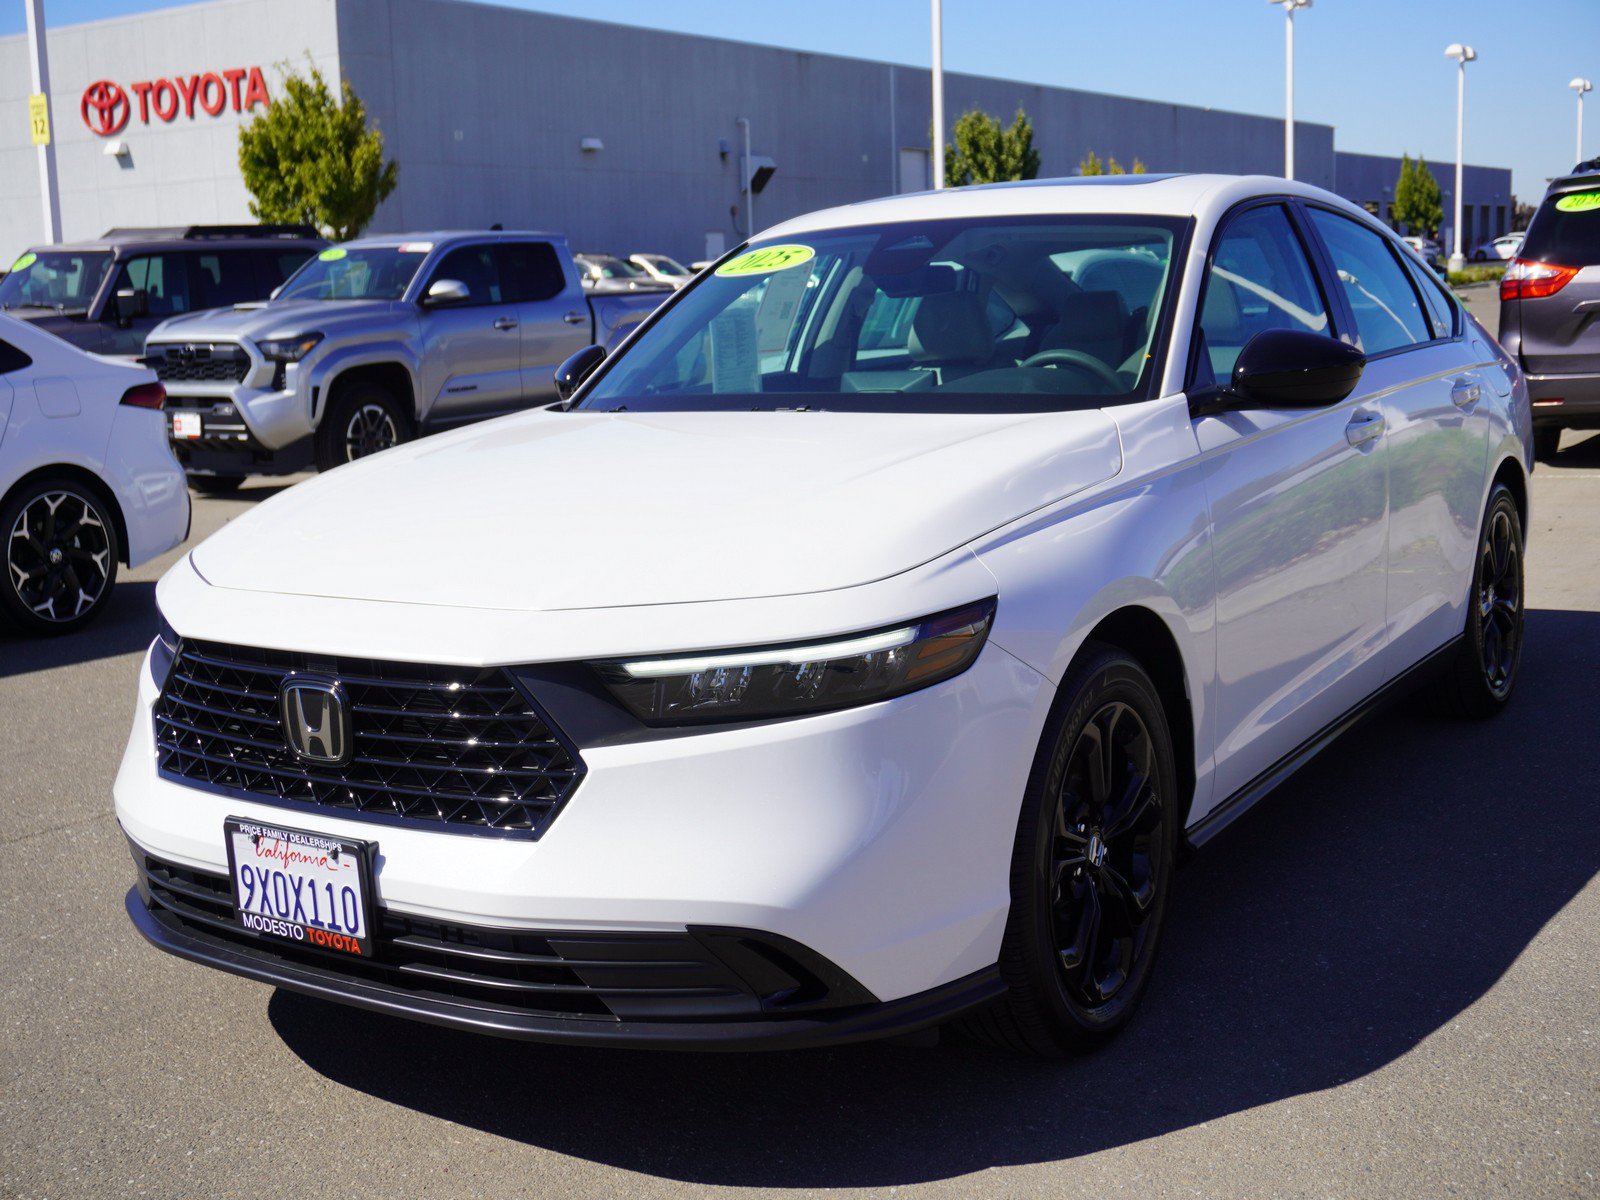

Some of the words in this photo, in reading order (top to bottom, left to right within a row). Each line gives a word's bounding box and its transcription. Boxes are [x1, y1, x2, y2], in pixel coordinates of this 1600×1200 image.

[131, 66, 270, 125] TOYOTA
[34, 118, 46, 135] 12
[724, 249, 803, 272] 2025
[239, 824, 262, 837] PRICE
[262, 827, 289, 842] FAMILY
[289, 833, 343, 852] DEALERSHIPS
[255, 835, 338, 872] California
[242, 912, 304, 941] MODESTO
[305, 927, 362, 955] TOYOTA
